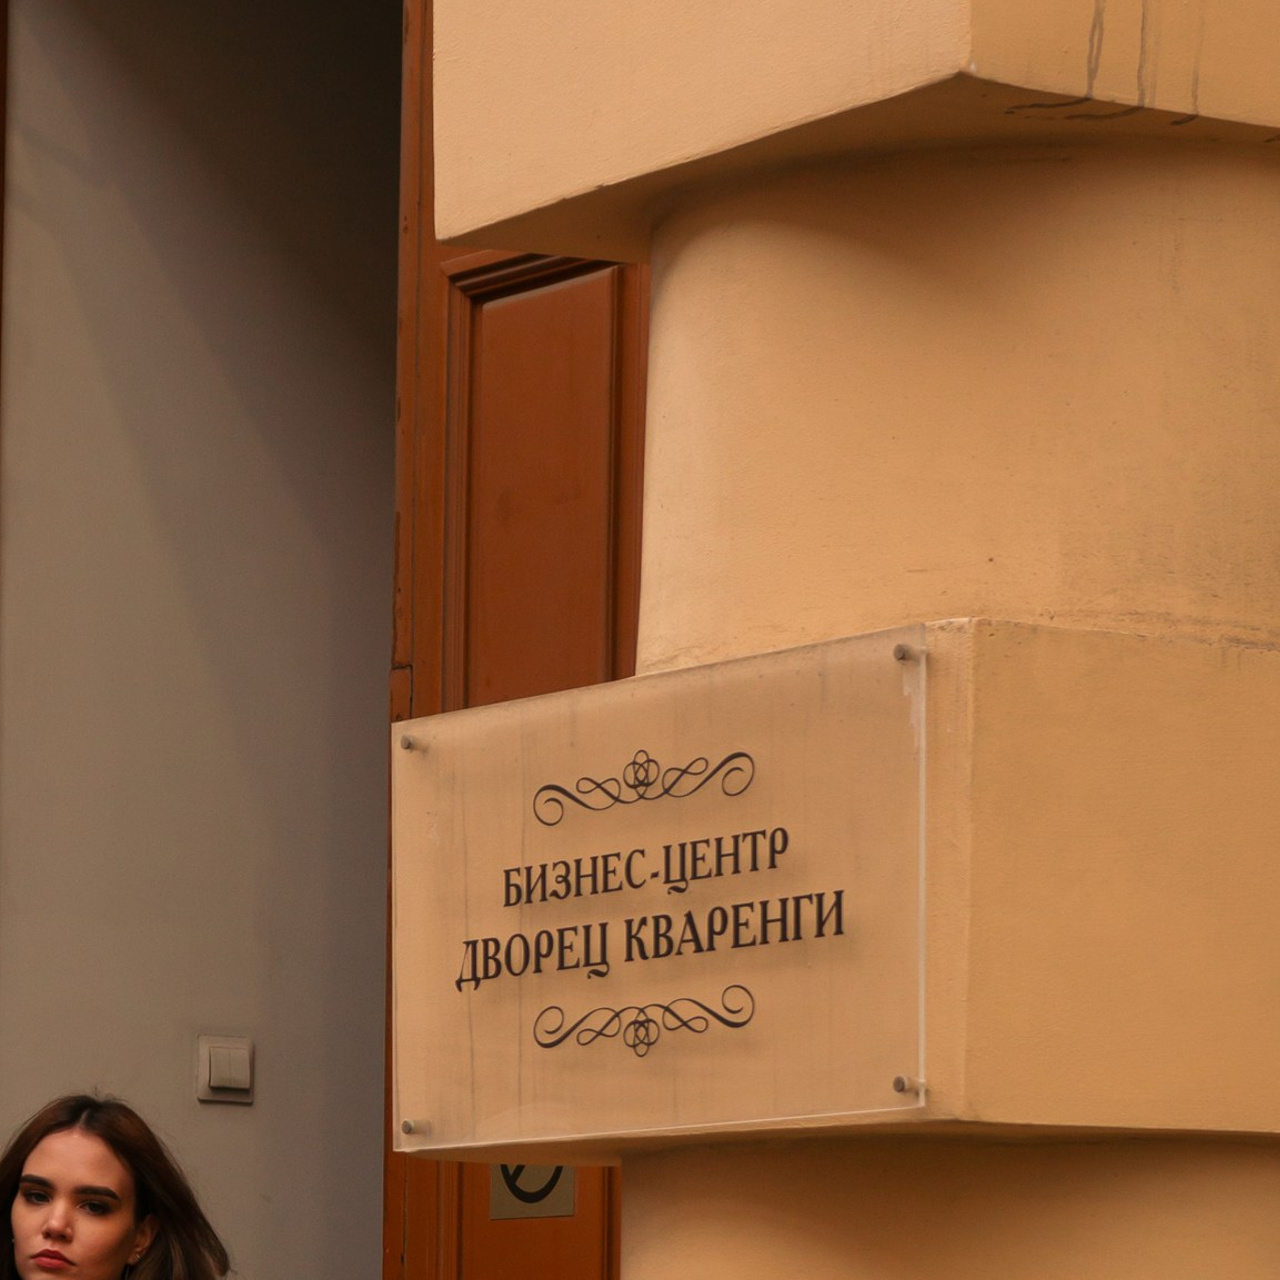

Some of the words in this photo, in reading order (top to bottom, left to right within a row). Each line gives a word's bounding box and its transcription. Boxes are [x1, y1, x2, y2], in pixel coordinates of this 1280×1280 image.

[502, 826, 790, 908] БИЗНЕС-ЦЕНТР
[455, 921, 610, 993] ДВОРЕЦ
[623, 889, 846, 963] КВАРЕНГИ
